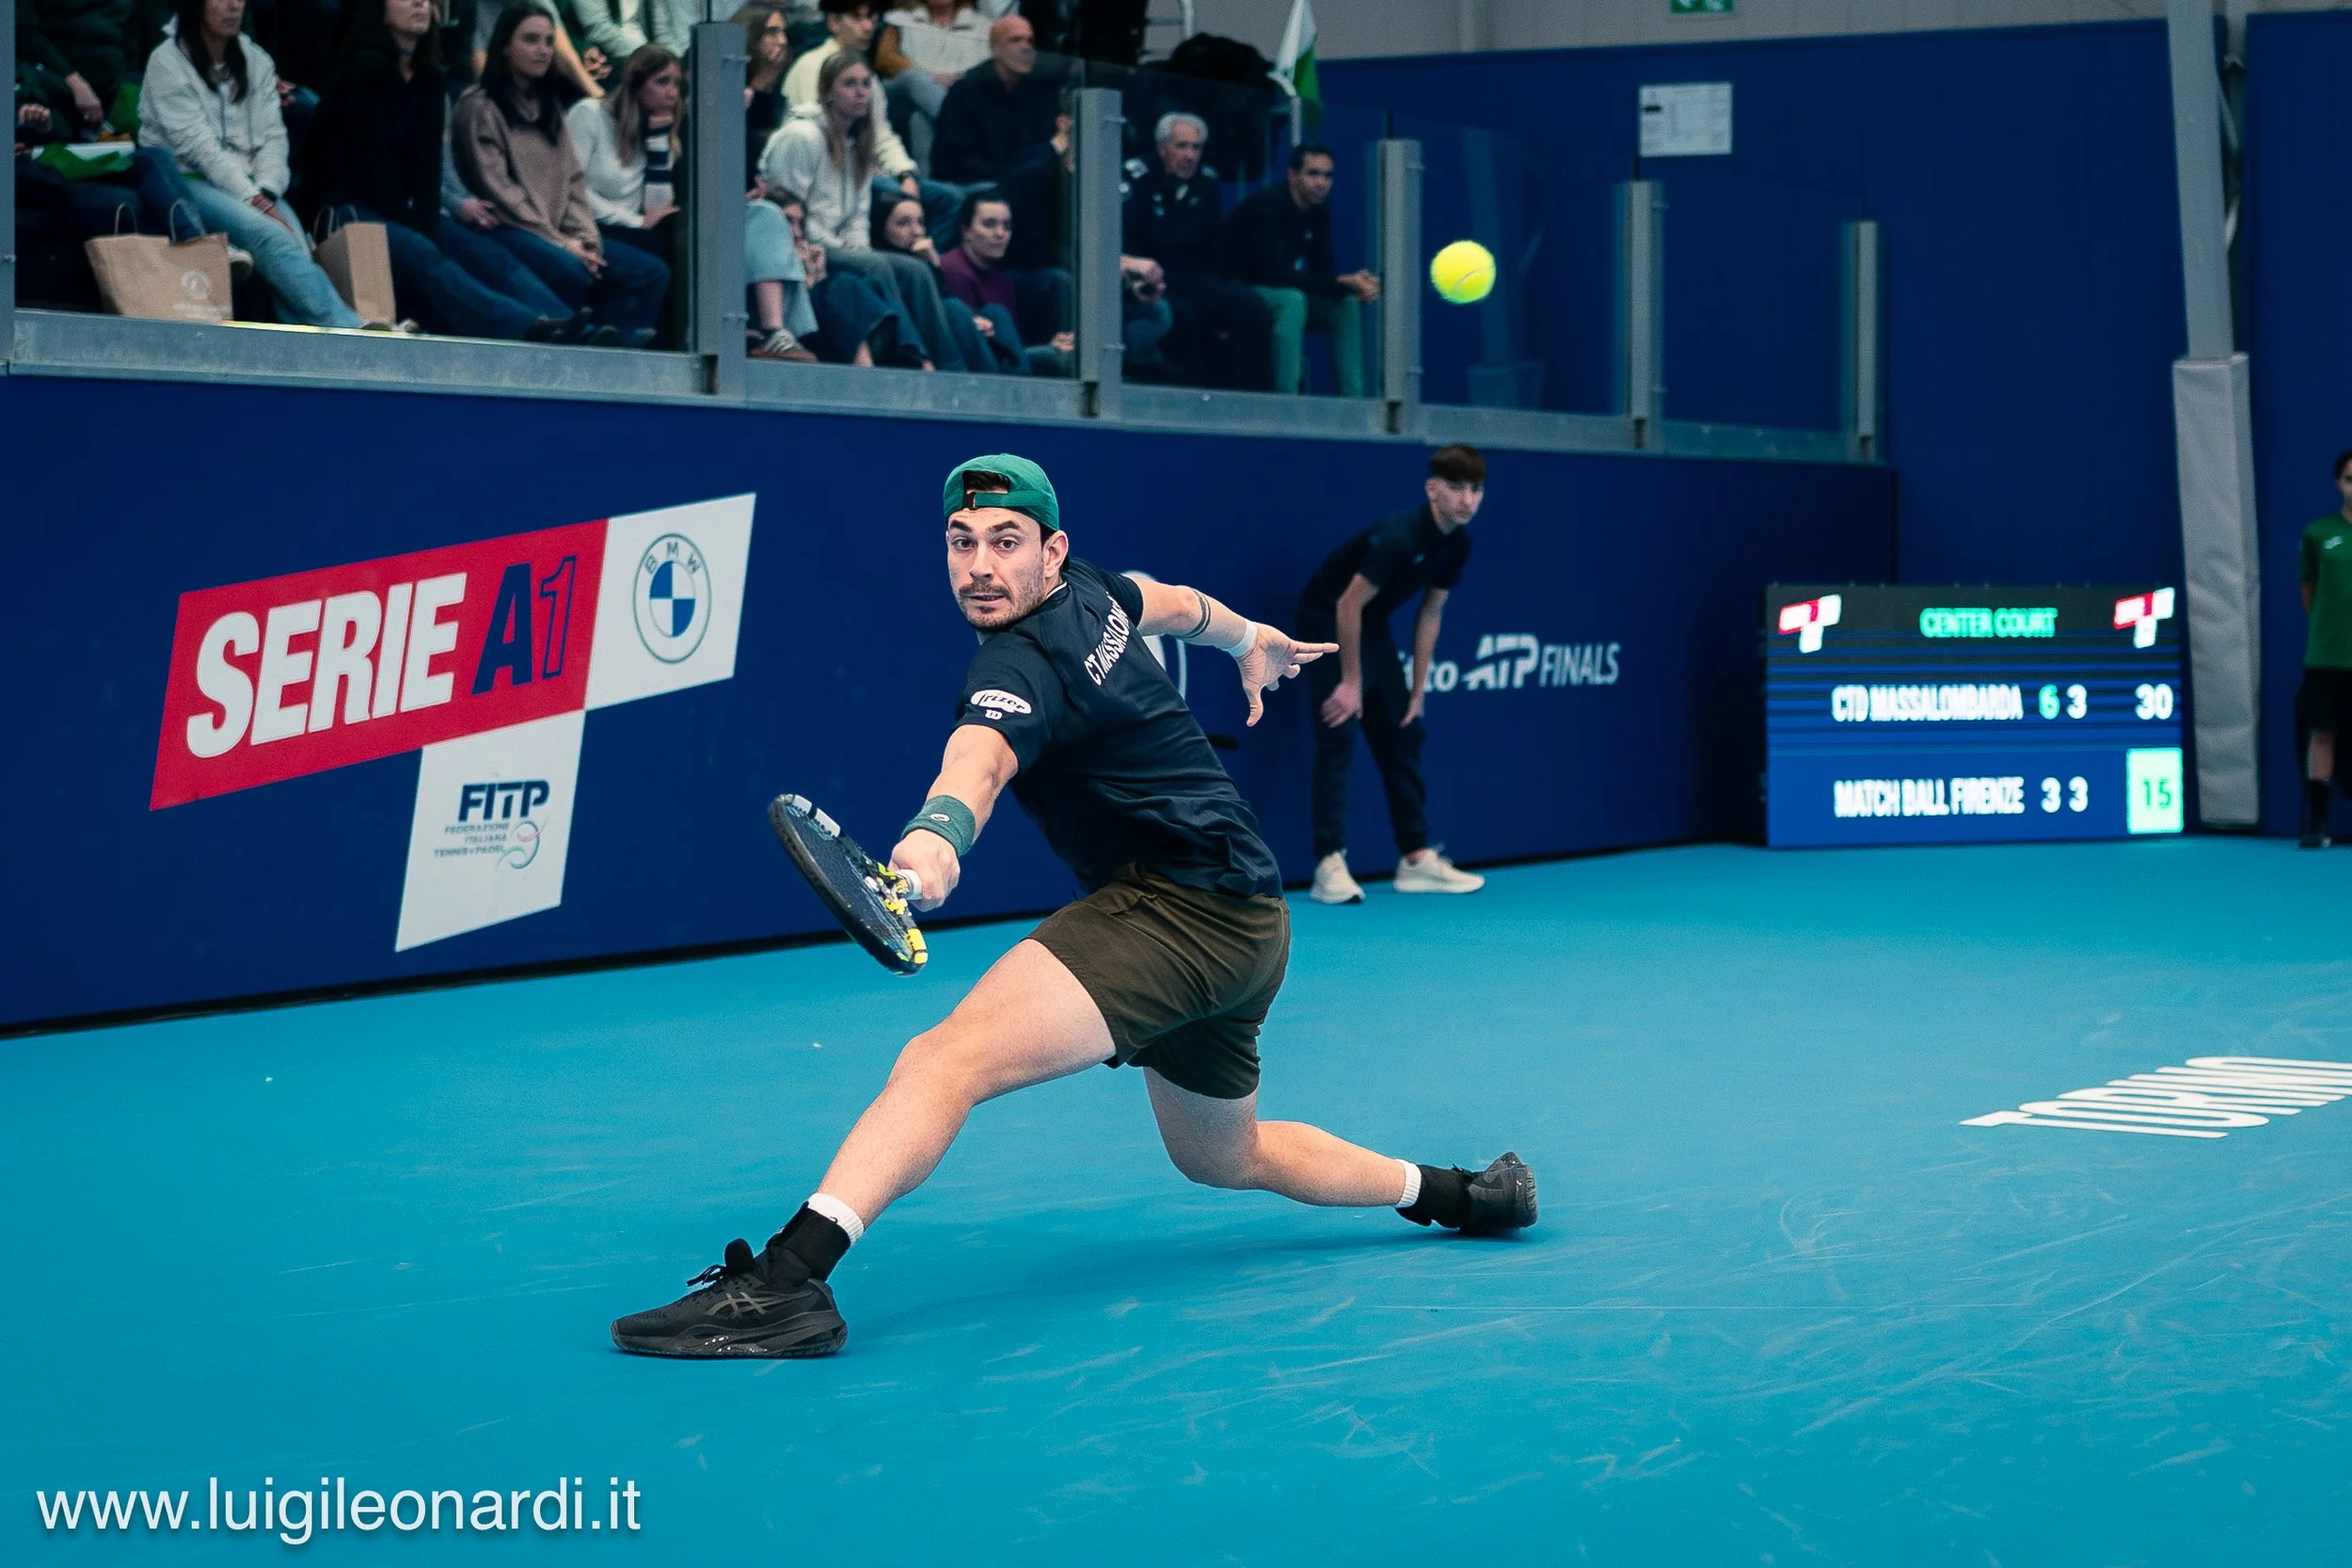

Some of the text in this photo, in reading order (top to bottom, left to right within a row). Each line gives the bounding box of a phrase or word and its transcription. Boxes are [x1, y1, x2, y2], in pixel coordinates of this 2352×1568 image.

[644, 542, 701, 575] BMW
[1919, 608, 2058, 638] CENTER COURT
[187, 555, 576, 757] SERIE A1
[1084, 654, 1106, 686] CT
[1462, 633, 1538, 690] ATP
[1539, 641, 1620, 688] FINALS
[1831, 683, 2174, 721] CTD MASSALOMBARDA 6 3 30
[458, 780, 549, 822] FITP
[1834, 776, 2171, 817] MATCH BALL FIRENZE 3 3 15
[1959, 1056, 2352, 1139] TORINO
